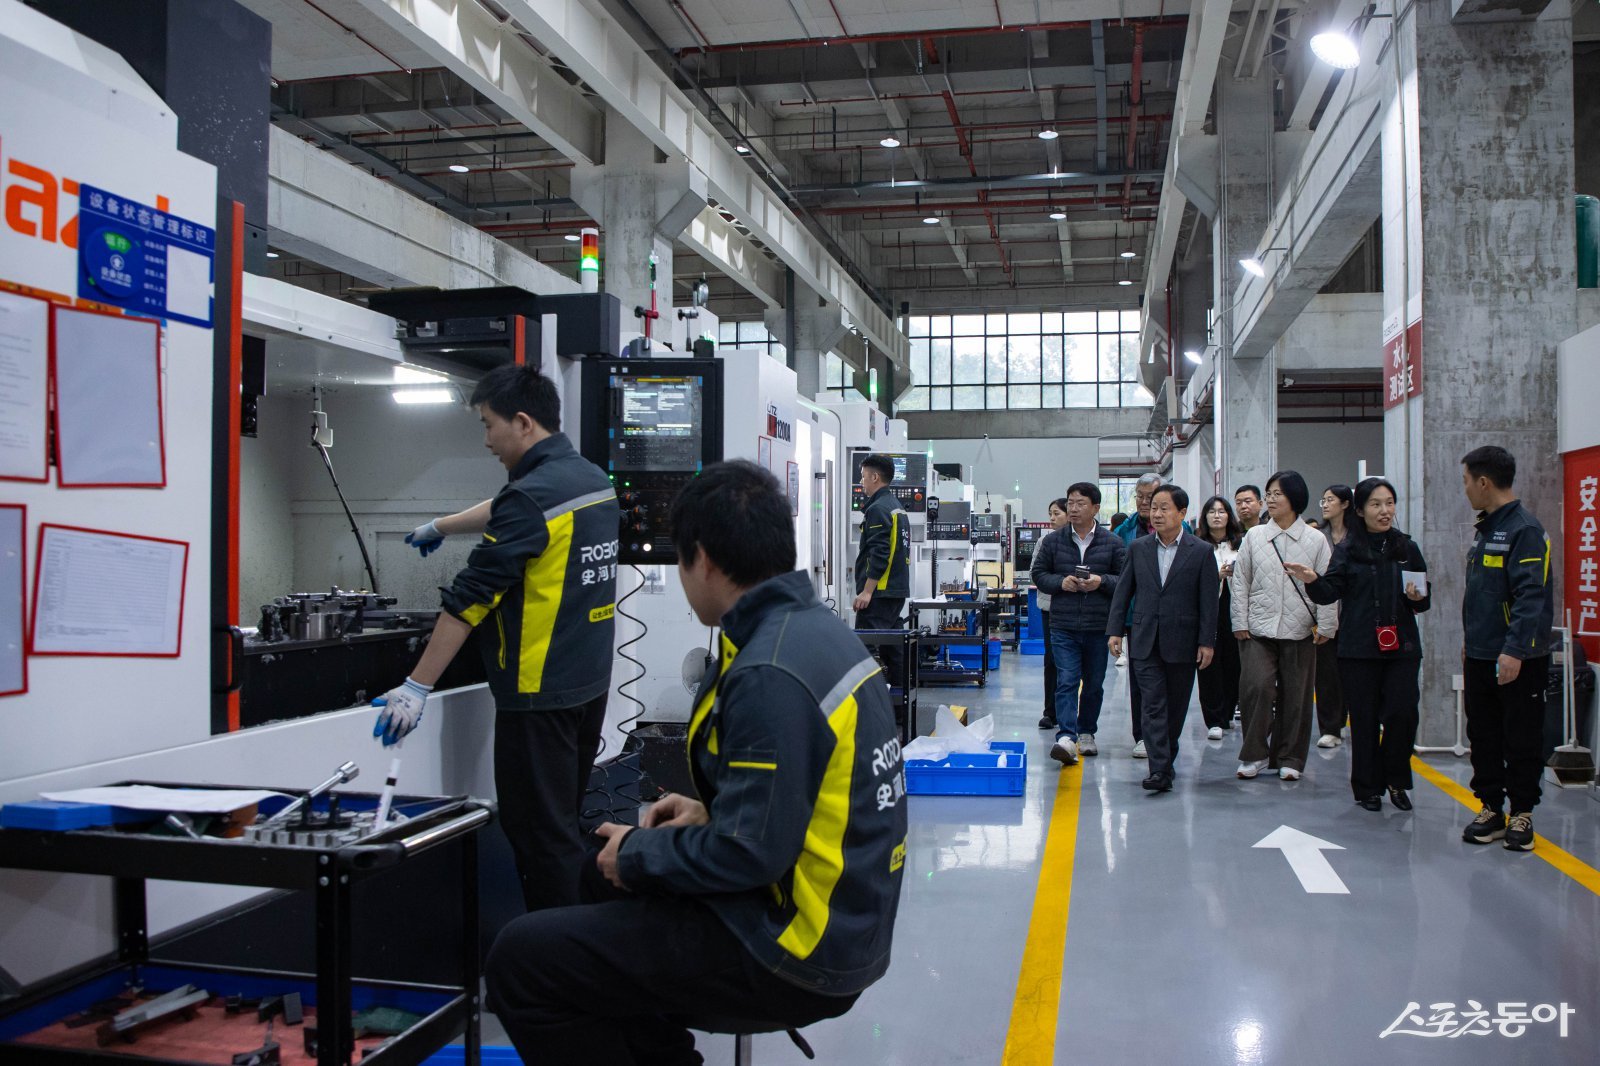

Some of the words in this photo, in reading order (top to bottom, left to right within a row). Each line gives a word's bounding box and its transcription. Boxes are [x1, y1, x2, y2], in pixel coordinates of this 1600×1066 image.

[89, 191, 208, 244] 设备状态管理标识
[1579, 475, 1599, 633] 安全生产
